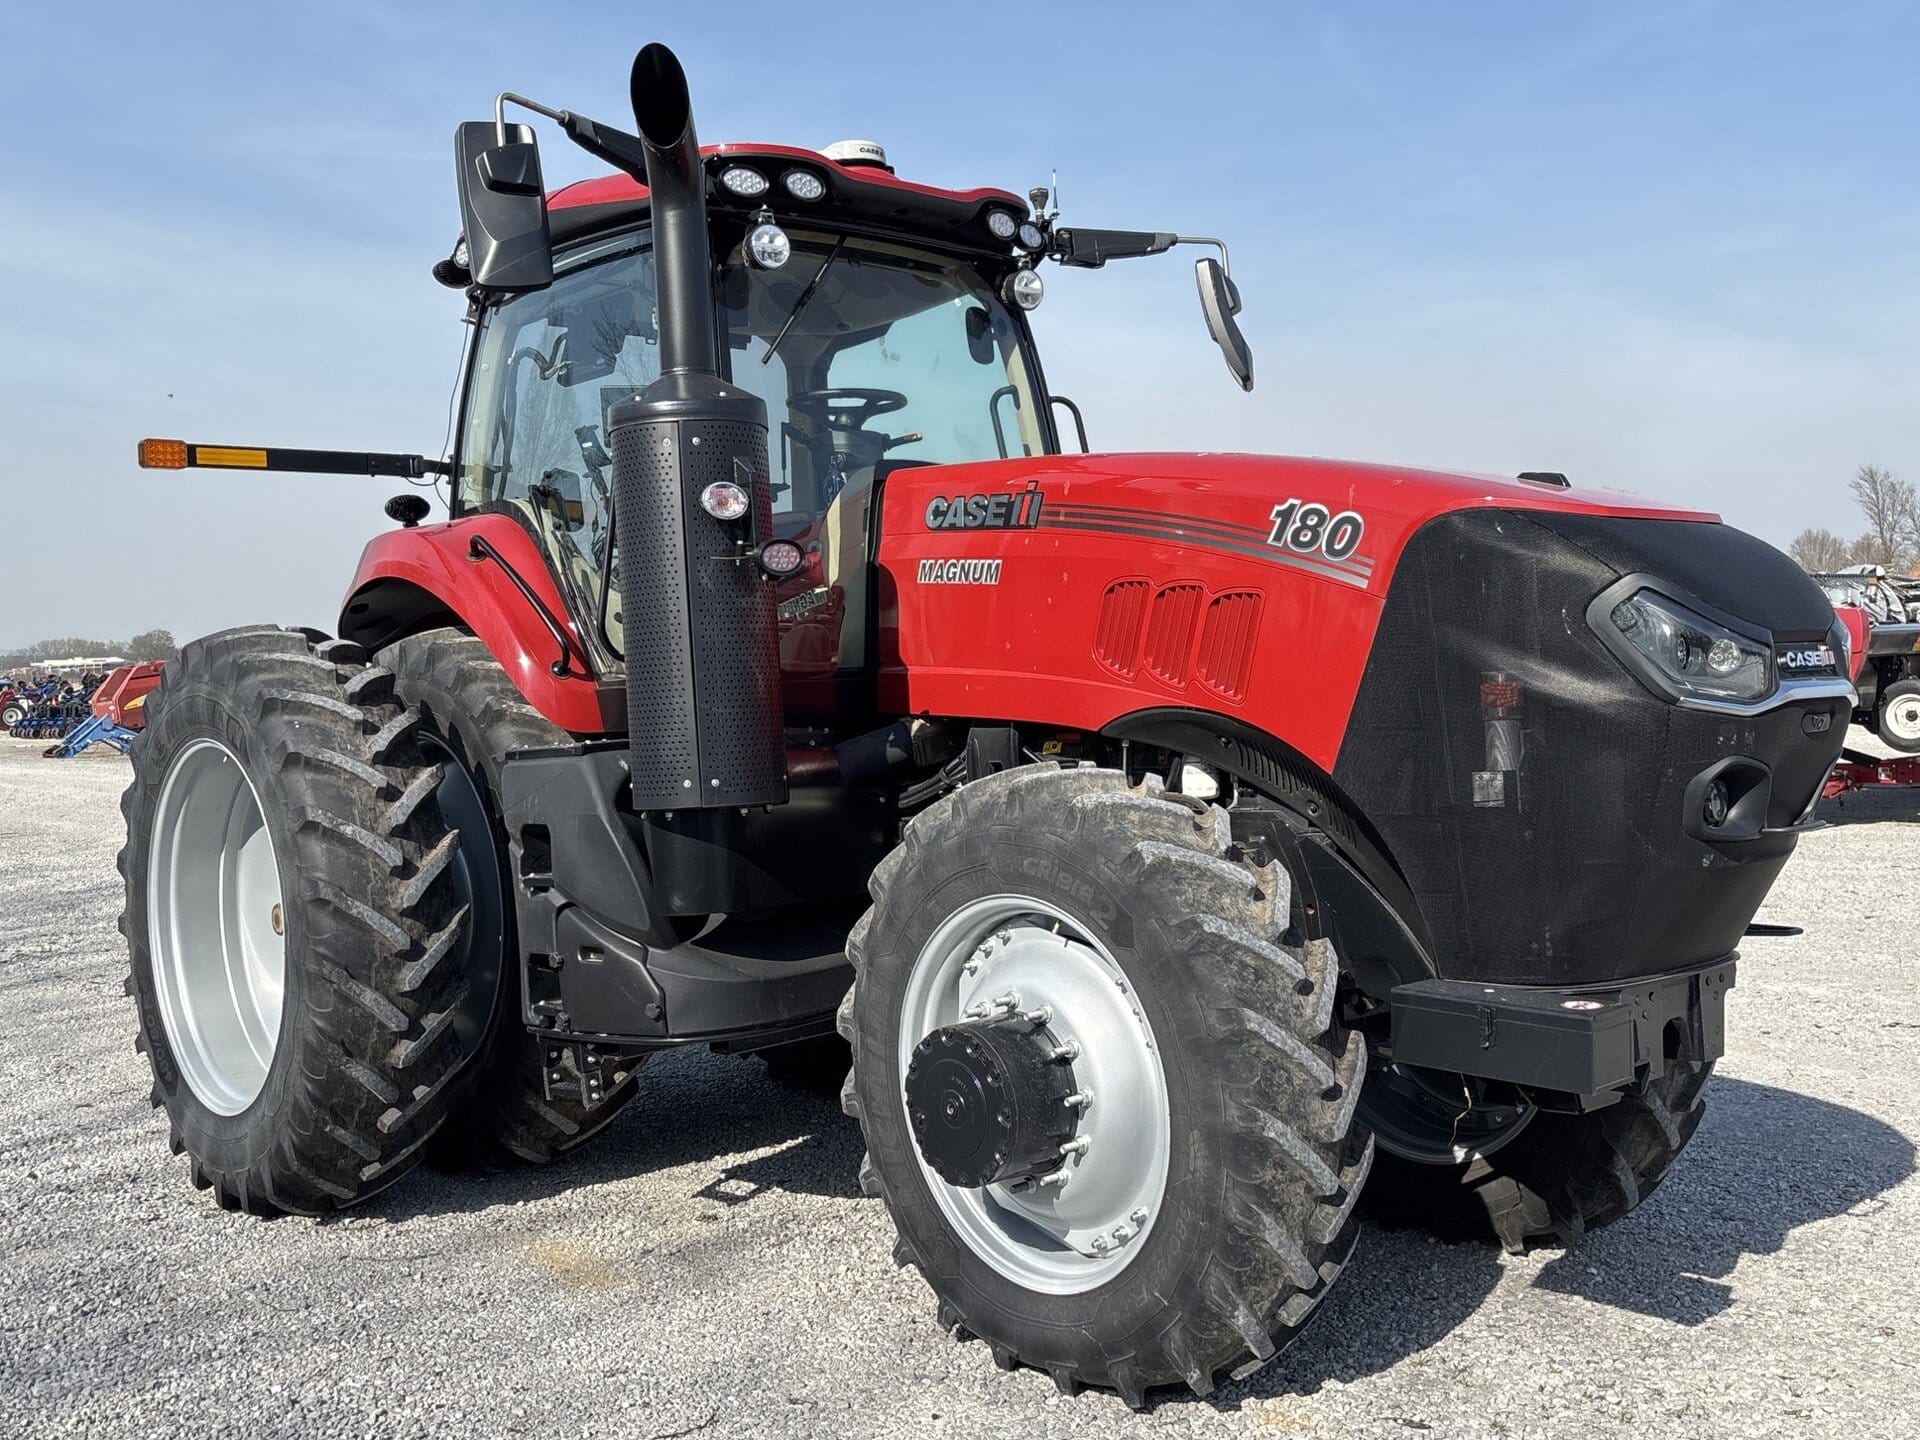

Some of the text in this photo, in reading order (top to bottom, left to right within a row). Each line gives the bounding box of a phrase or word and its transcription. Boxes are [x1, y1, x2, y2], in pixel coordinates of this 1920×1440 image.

[925, 494, 1011, 531] CASE
[1267, 498, 1364, 561] 180
[917, 559, 1003, 585] MAGNUM
[1786, 651, 1822, 668] CASE
